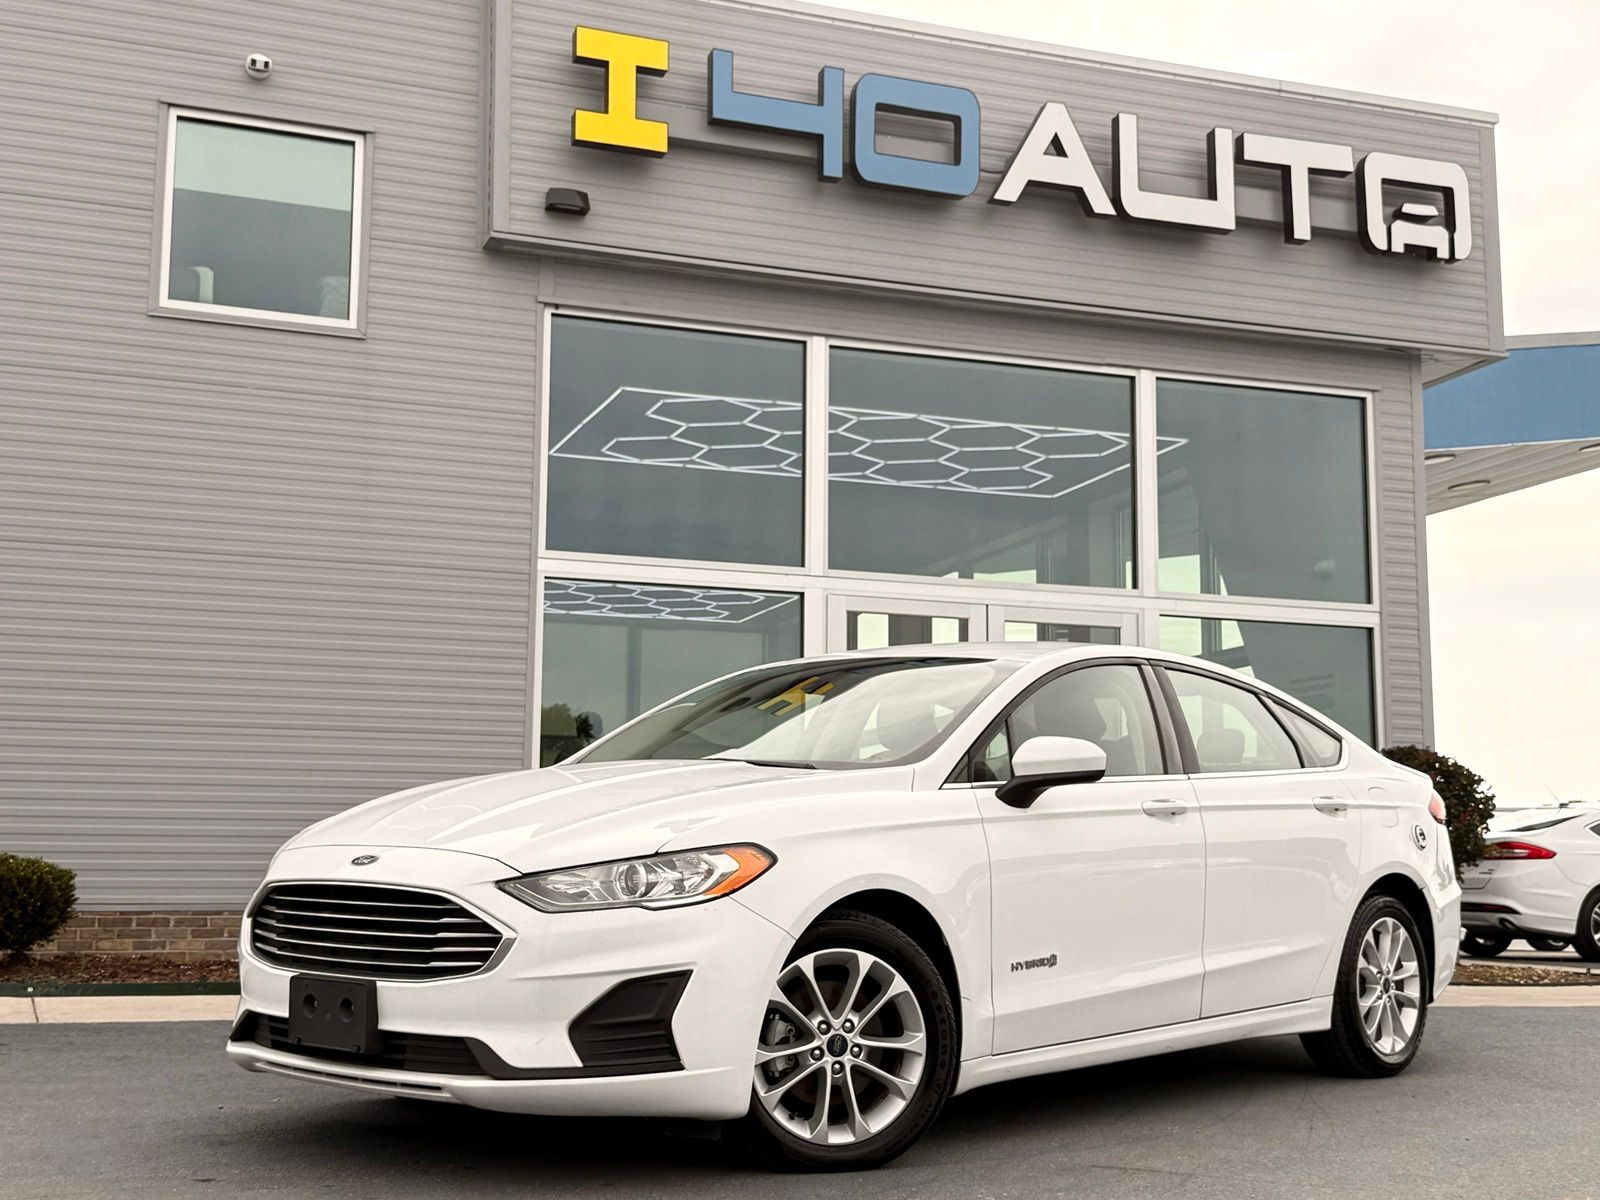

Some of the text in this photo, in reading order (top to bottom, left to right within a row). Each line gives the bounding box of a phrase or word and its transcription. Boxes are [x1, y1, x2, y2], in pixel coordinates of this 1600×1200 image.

[572, 25, 1472, 262] I 40 AUTO
[1011, 957, 1049, 972] HYBRID
